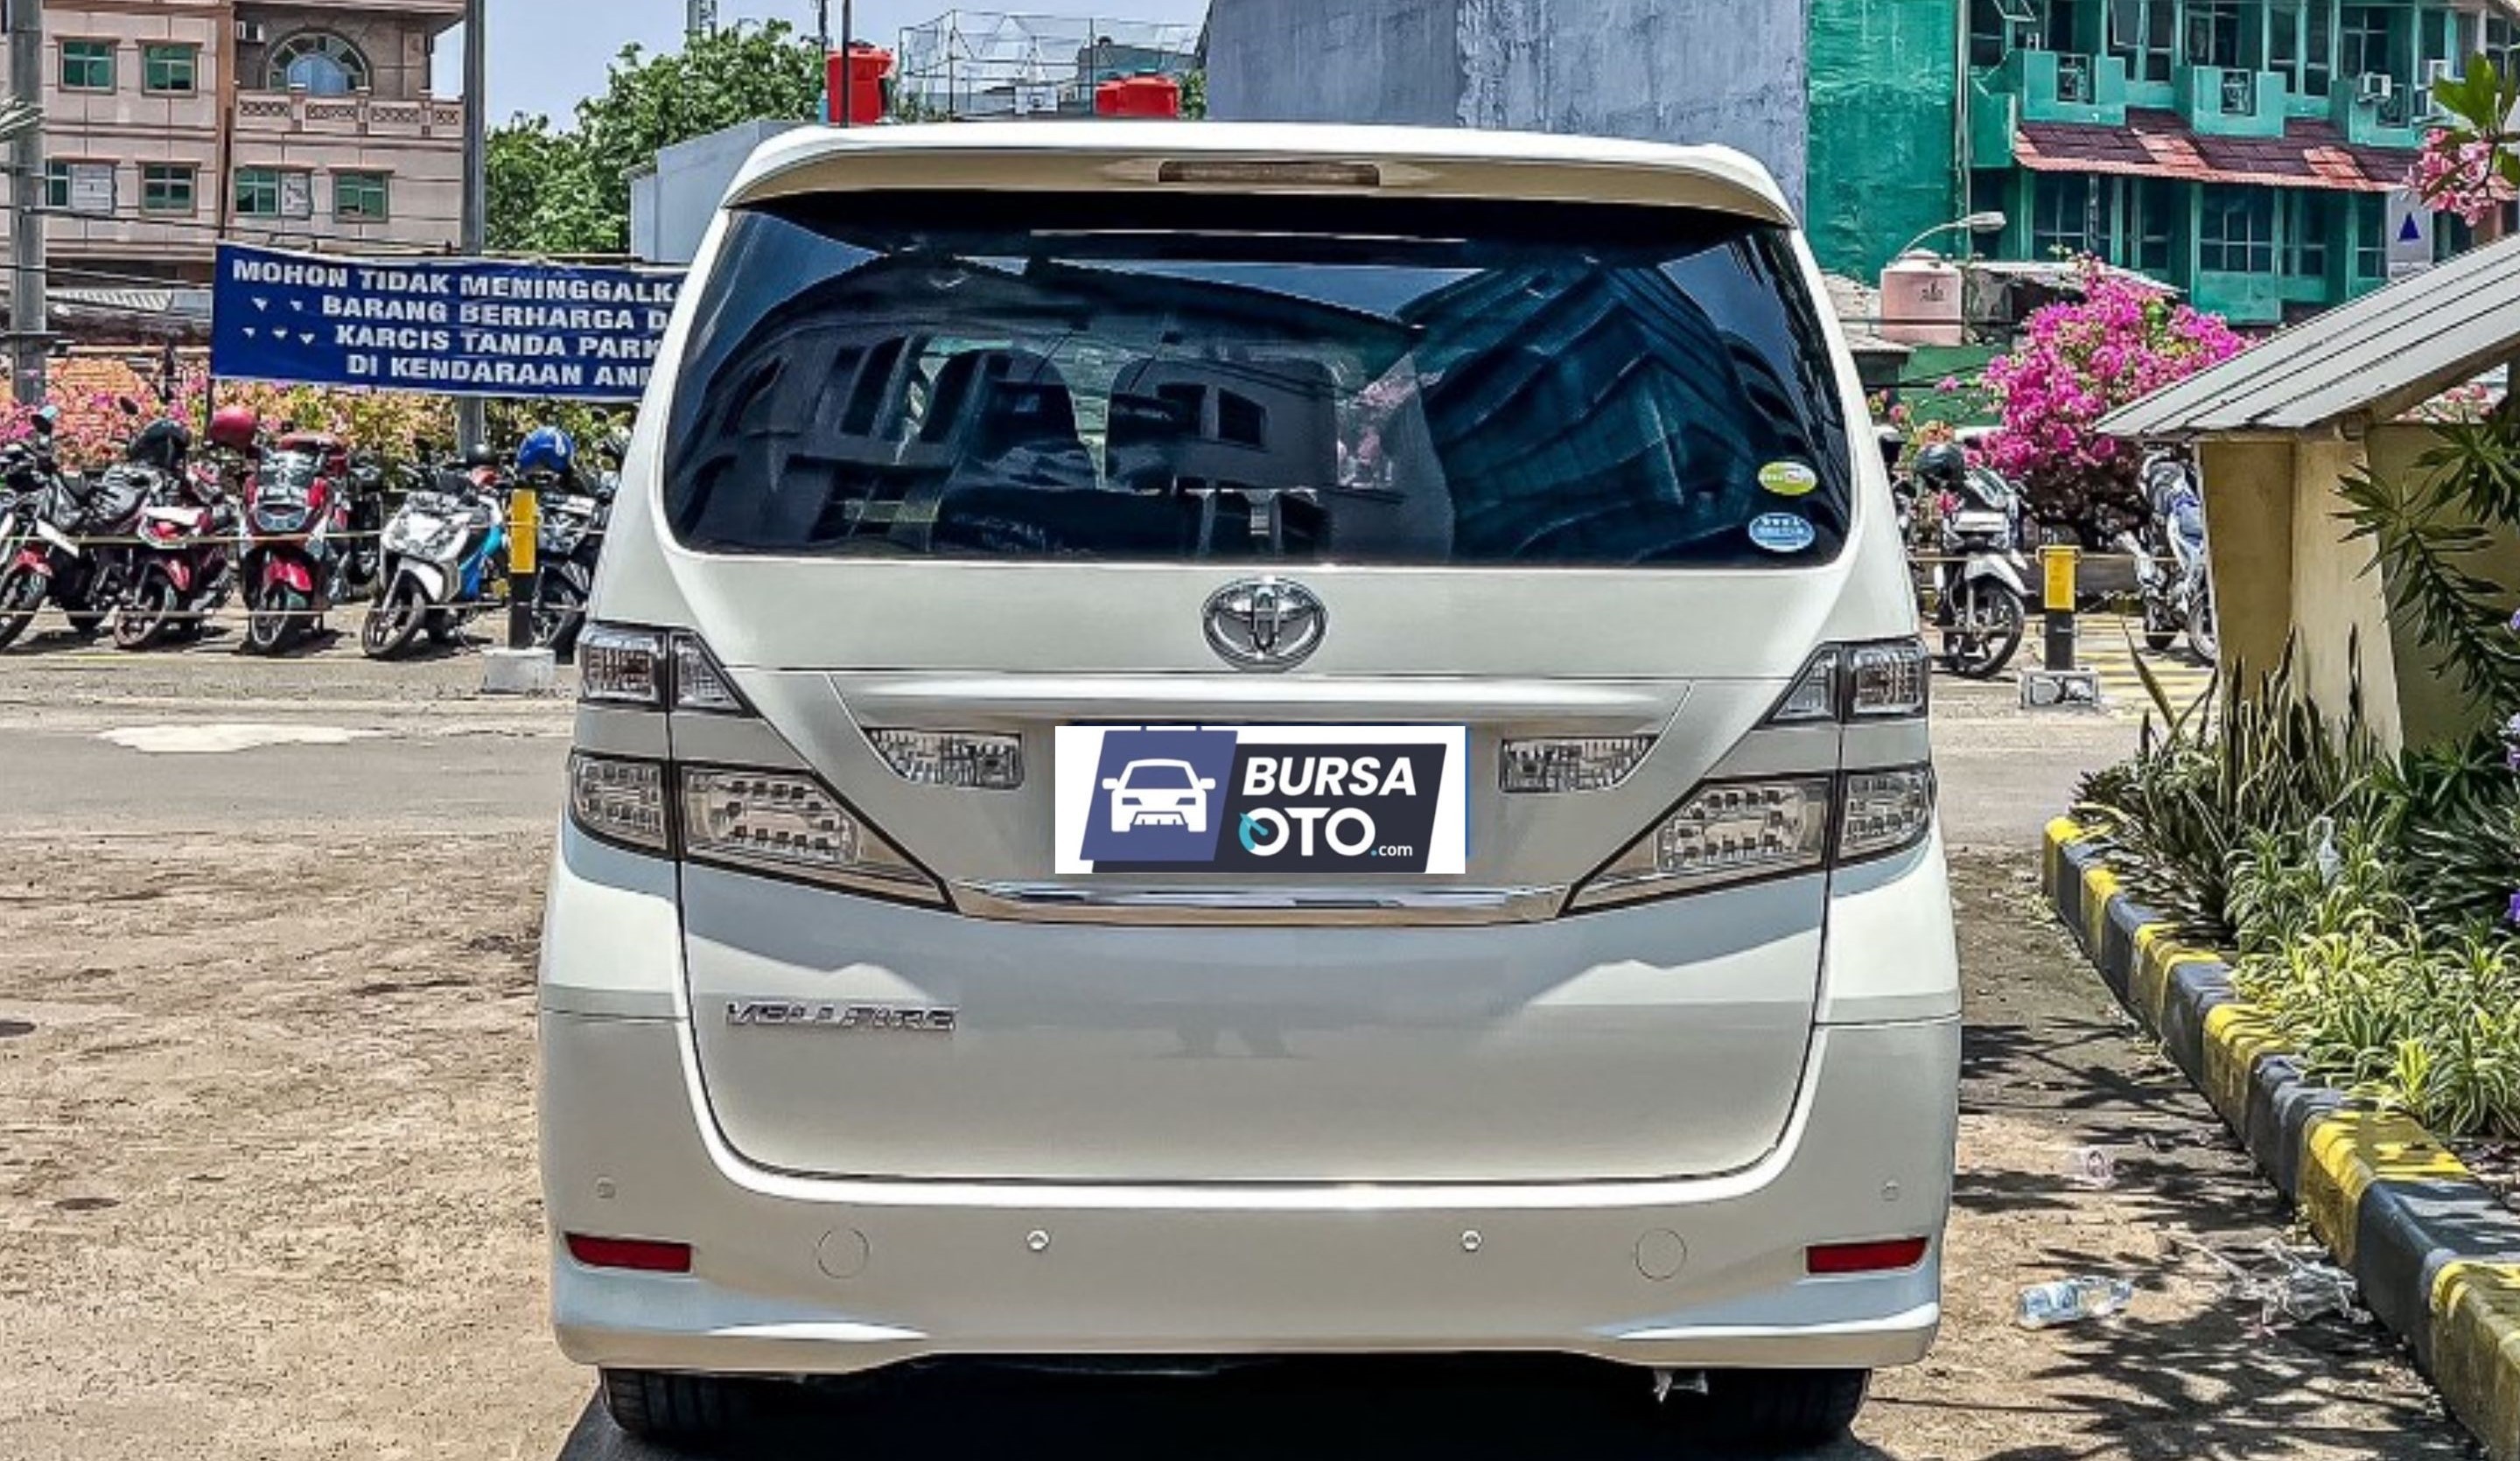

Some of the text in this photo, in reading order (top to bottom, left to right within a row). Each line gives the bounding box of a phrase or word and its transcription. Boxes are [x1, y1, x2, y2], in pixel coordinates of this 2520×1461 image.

[233, 259, 348, 287] MOHON
[358, 269, 450, 294] TIDAK
[322, 295, 447, 323] BARANG
[459, 304, 634, 330] BERHARGA
[334, 324, 450, 351] KARCIS
[460, 330, 566, 357] TANDA
[346, 354, 378, 376] DI
[391, 357, 582, 386] KENDARAAN
